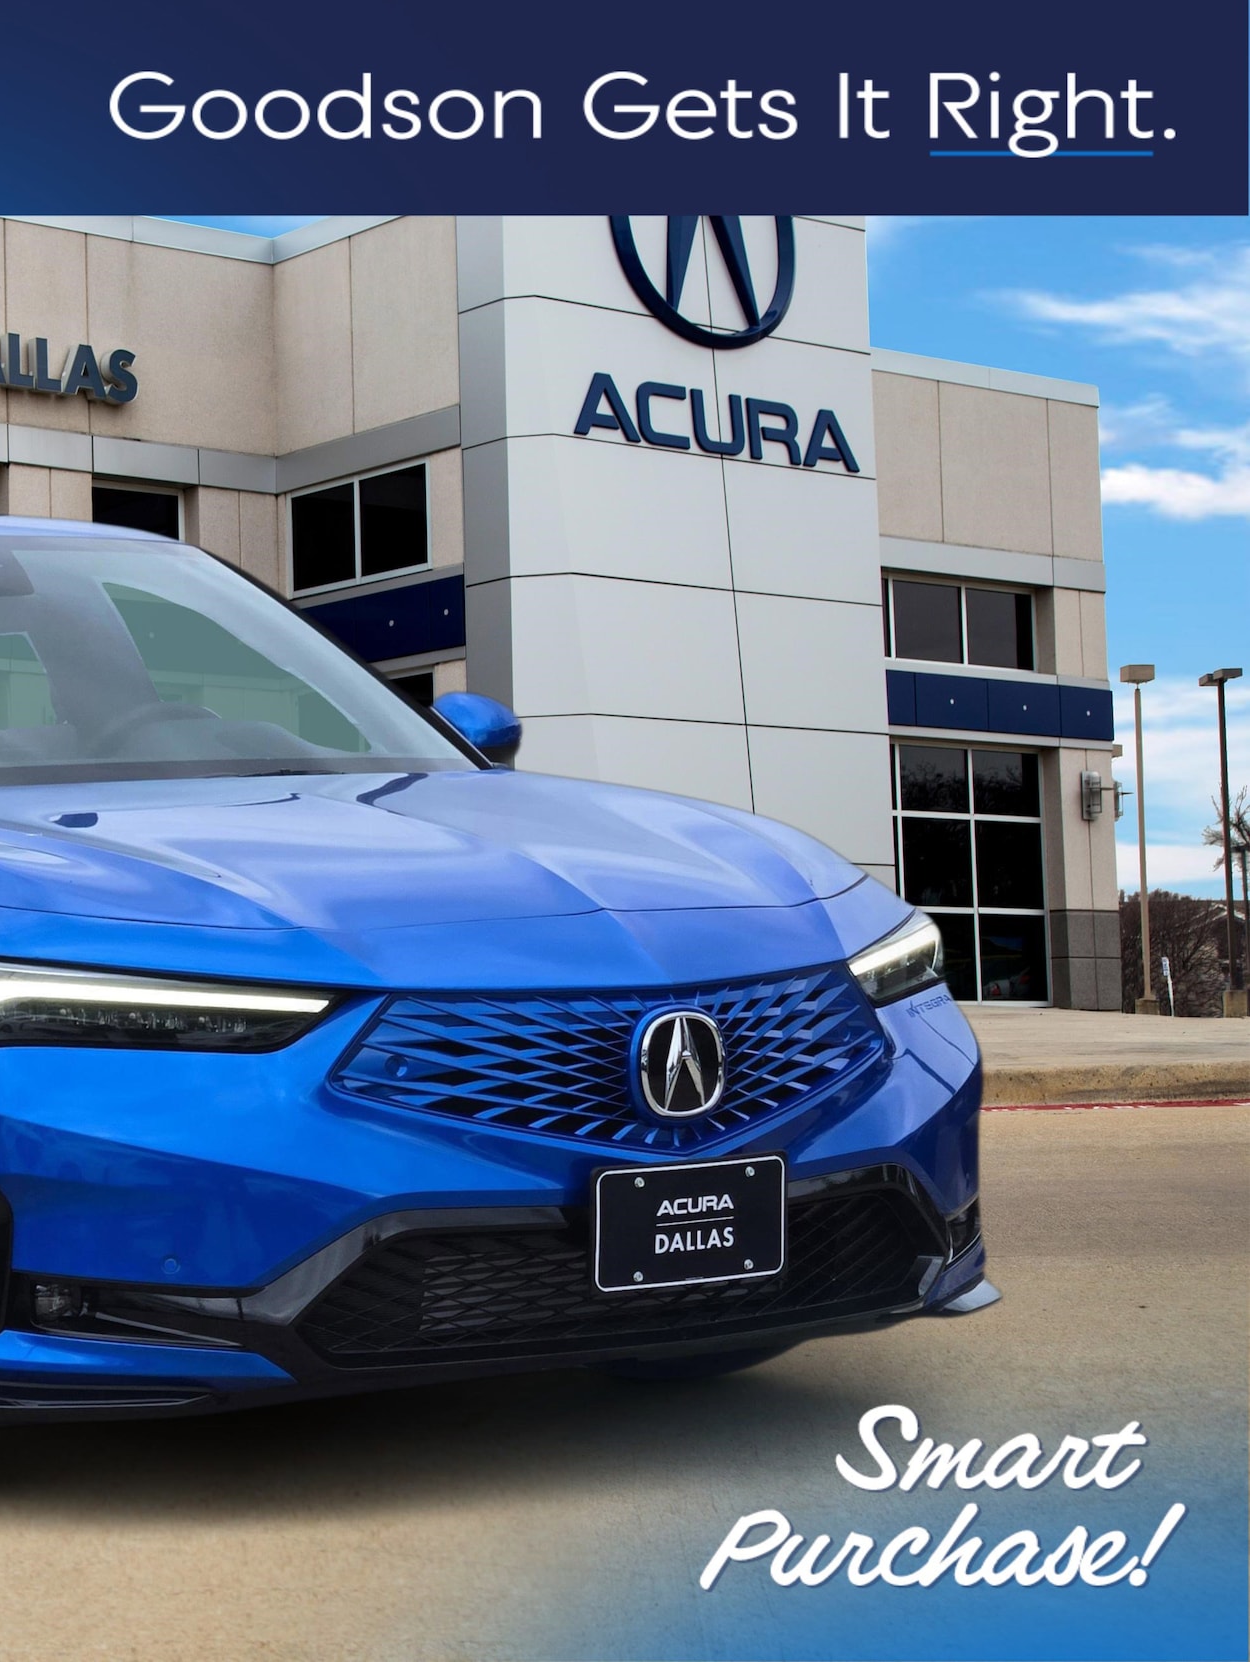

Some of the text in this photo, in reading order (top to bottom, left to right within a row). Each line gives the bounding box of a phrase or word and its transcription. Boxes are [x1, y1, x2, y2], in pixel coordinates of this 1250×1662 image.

[573, 372, 860, 473] ACURA
[906, 994, 952, 1018] INTEGRA
[656, 1193, 734, 1217] ACURA
[654, 1226, 735, 1255] DALLAS
